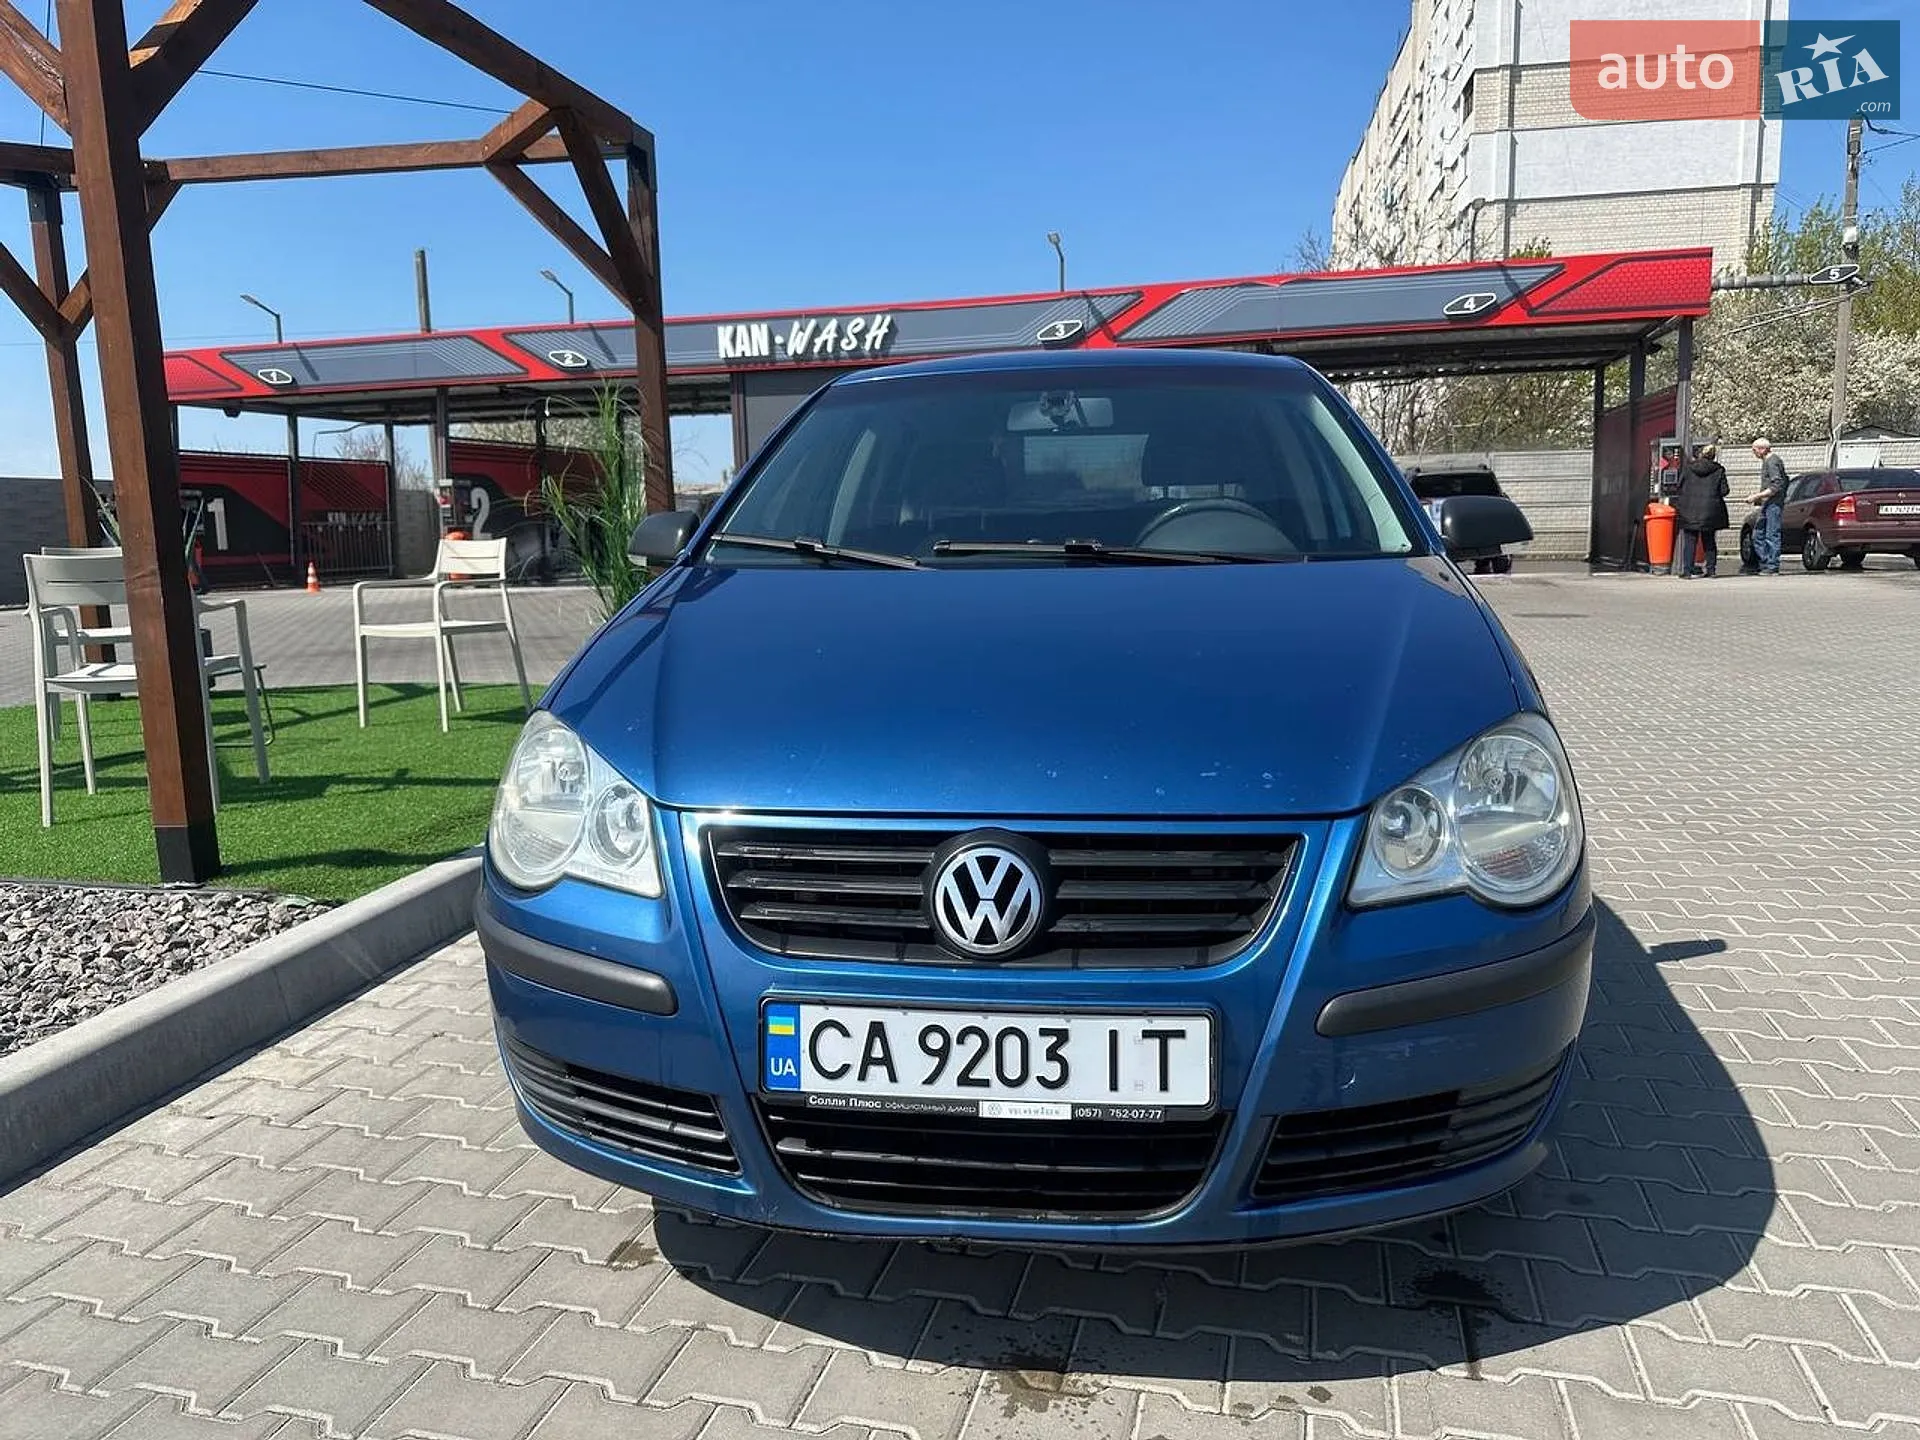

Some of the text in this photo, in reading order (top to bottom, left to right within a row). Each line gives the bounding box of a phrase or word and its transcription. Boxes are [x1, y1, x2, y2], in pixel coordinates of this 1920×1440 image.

[1829, 268, 1839, 280] 5
[1464, 297, 1475, 311] 4
[717, 314, 891, 358] KAN WASH
[1056, 324, 1065, 336] 3
[564, 353, 573, 365] 2
[271, 371, 277, 382] 1
[470, 487, 492, 540] 2
[207, 498, 228, 550] 1
[808, 1019, 1186, 1093] CA 9203 IT
[770, 1057, 797, 1077] UA
[808, 1095, 846, 1107] Солли
[849, 1097, 882, 1109] Плюс
[1075, 1107, 1102, 1119] (057)
[1109, 1108, 1163, 1120] 752-07-77
